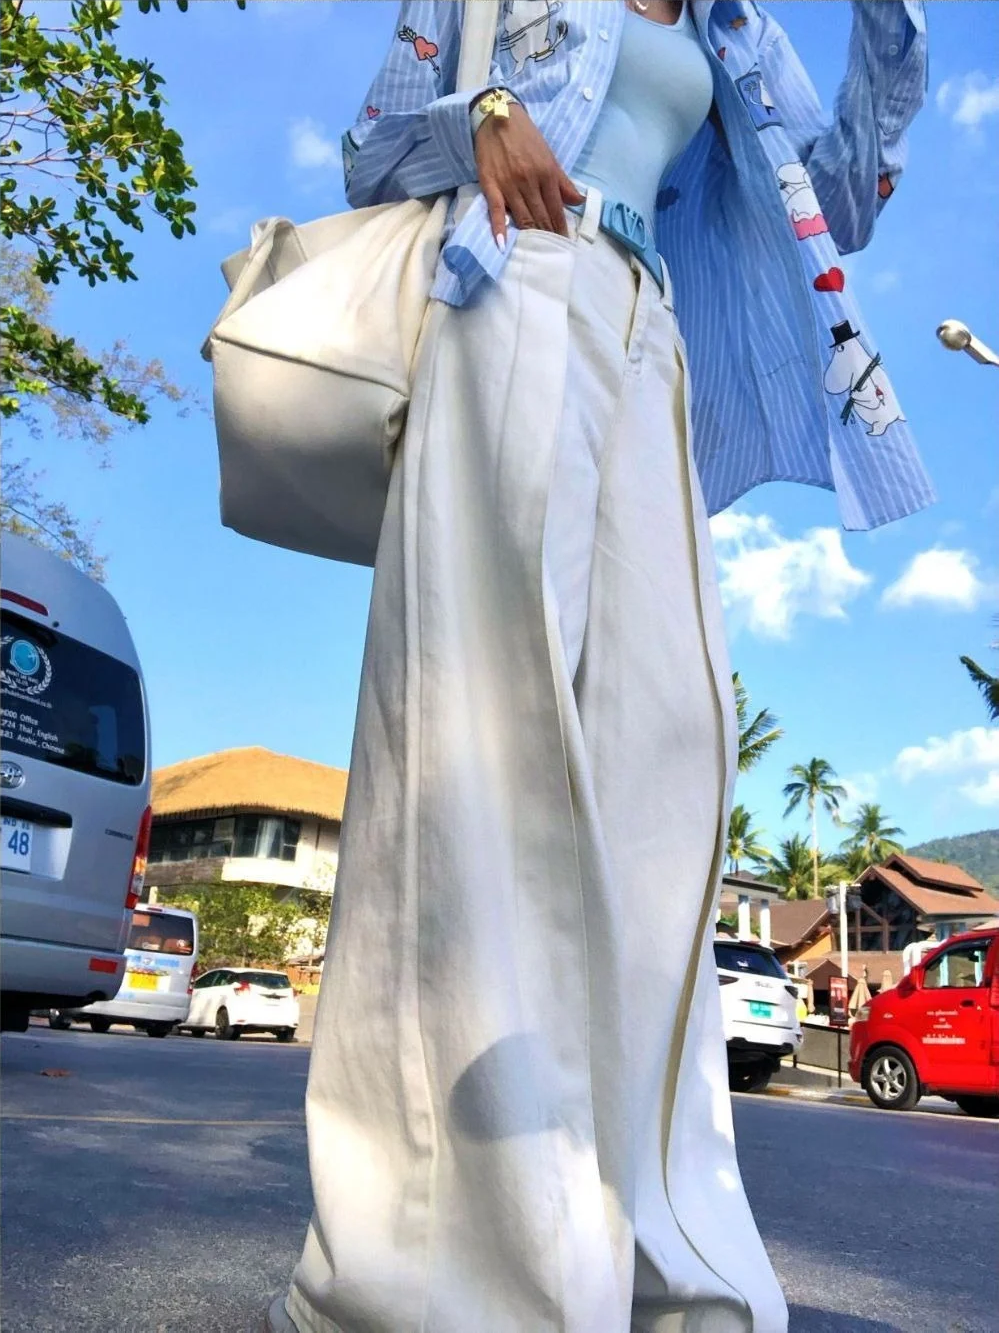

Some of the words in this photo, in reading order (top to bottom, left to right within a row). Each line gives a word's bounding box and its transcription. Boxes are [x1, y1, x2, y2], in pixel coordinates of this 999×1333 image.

[19, 714, 39, 726] Office
[37, 730, 59, 742] English
[41, 742, 65, 755] Chinese
[8, 829, 30, 856] 48
